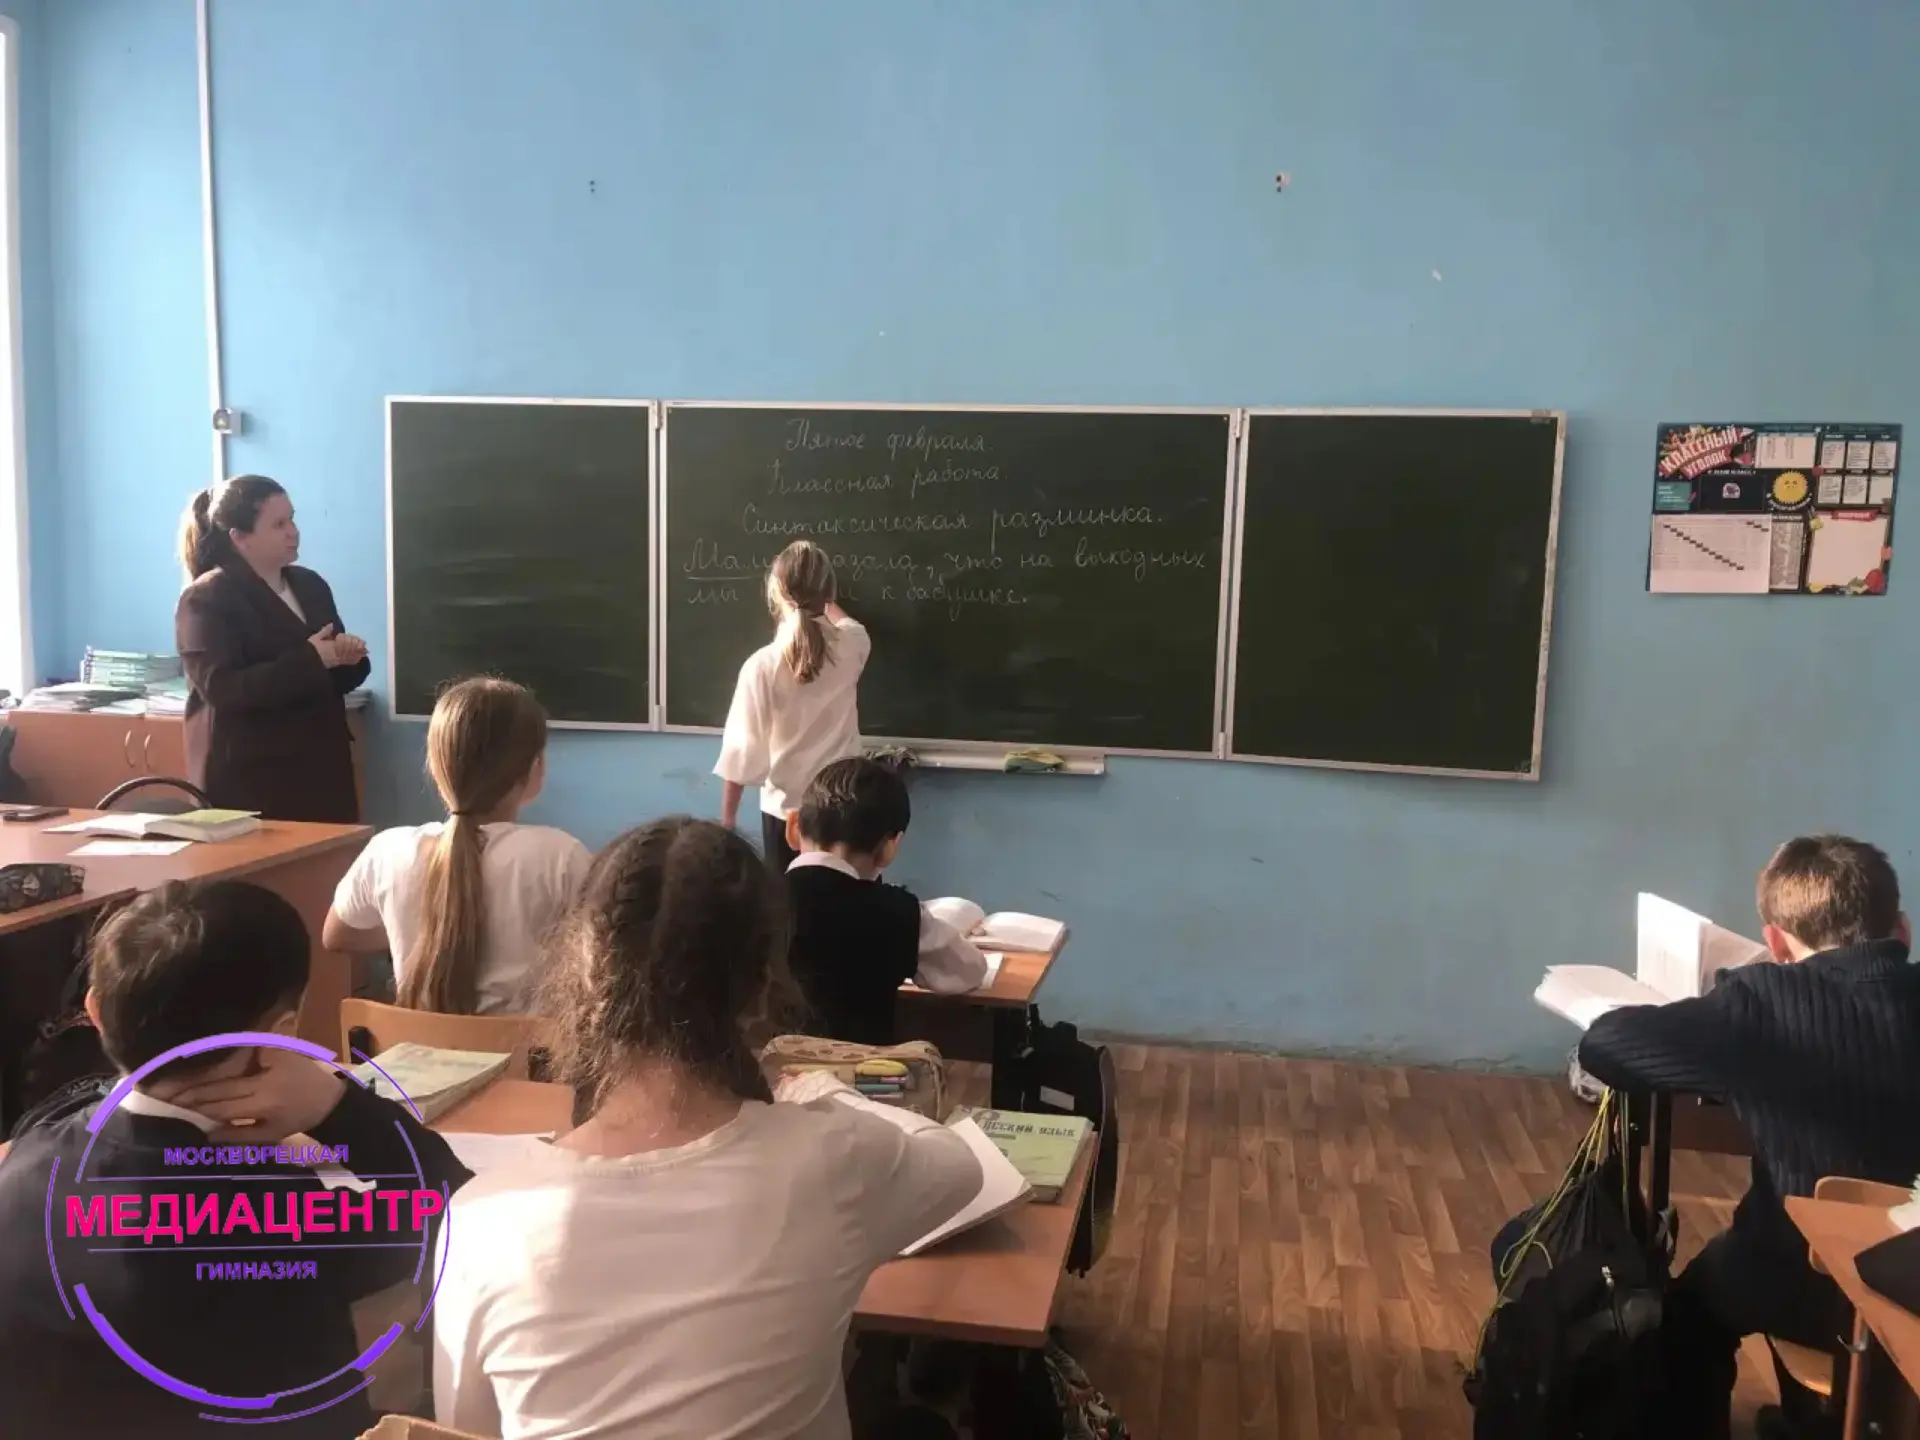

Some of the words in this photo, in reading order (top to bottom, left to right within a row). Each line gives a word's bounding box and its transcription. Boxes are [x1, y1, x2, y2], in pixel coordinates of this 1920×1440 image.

[785, 418, 866, 451] Пятое
[1660, 424, 1738, 473] КЛАССНЫЙ
[766, 458, 893, 495] Классная
[1683, 449, 1728, 477] УГОЛОК
[742, 502, 971, 536] Синтаксическая
[943, 552, 1003, 570] что
[1020, 551, 1054, 569] на
[1075, 536, 1207, 582] выходных
[881, 586, 896, 601] к
[1038, 1126, 1076, 1137] ЯЗЫК
